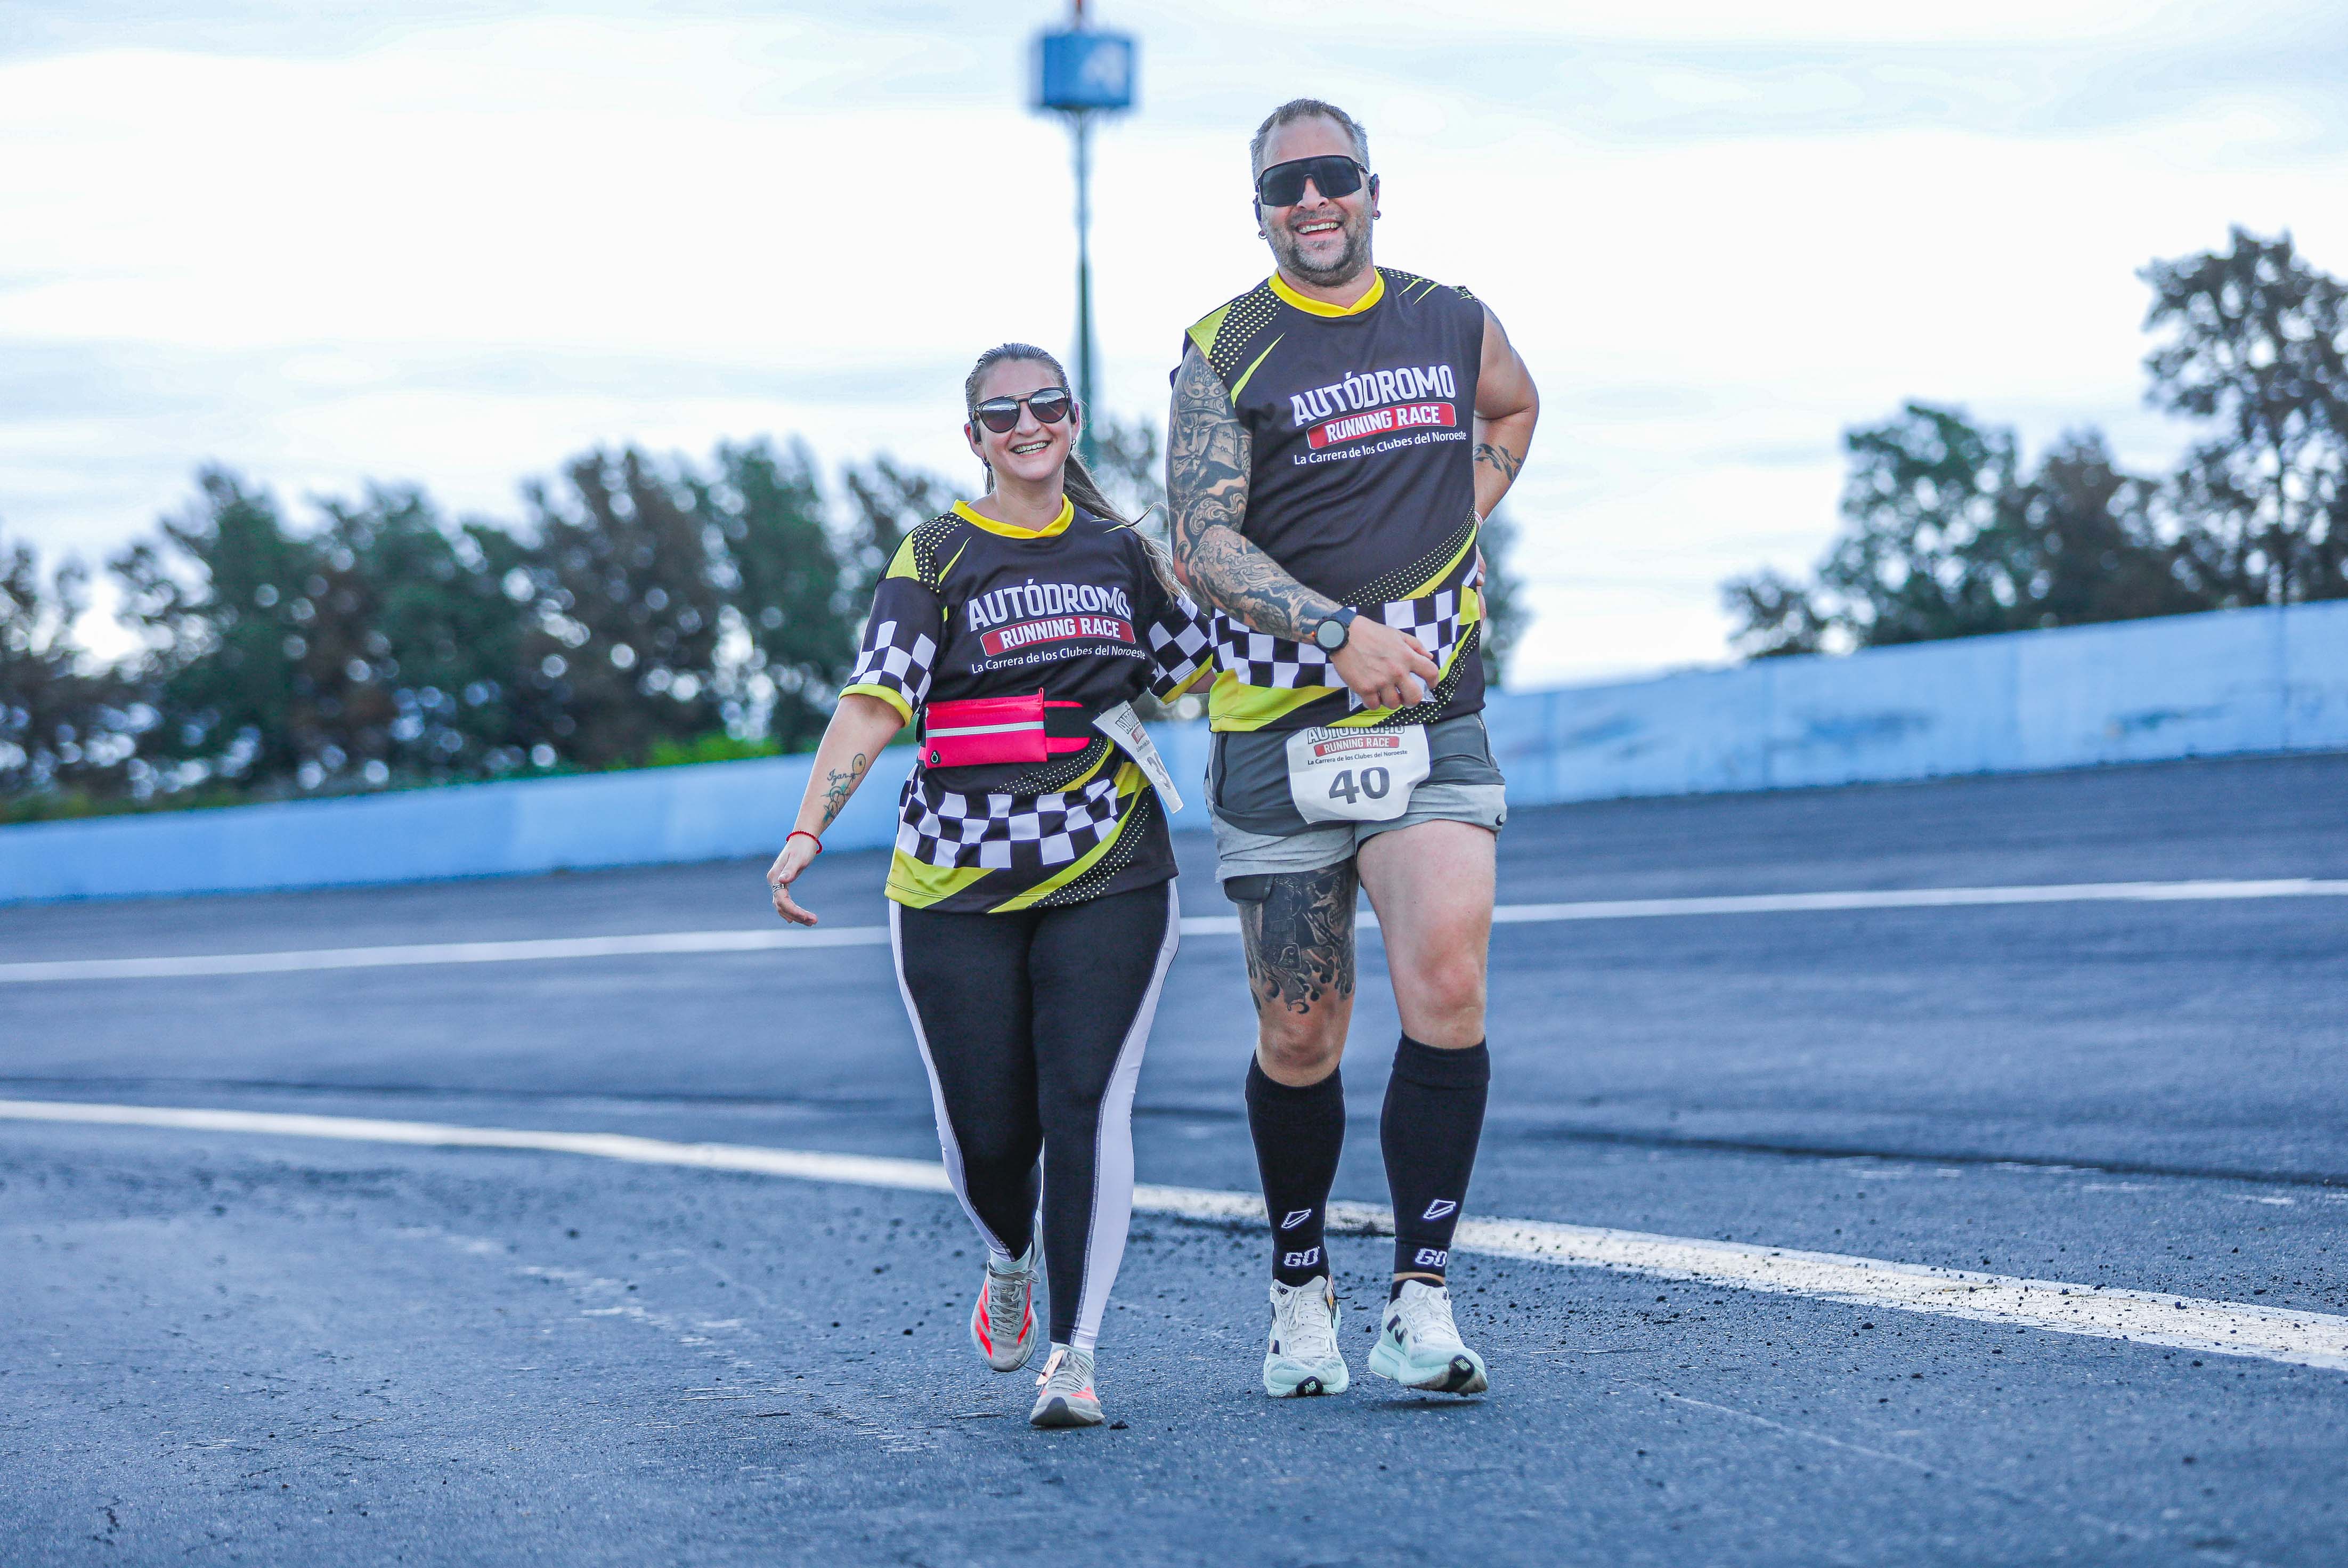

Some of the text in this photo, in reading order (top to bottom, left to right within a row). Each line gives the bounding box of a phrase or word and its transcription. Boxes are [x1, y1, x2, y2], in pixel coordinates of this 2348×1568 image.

[1289, 365, 1457, 427] AUTÓDROMO
[1325, 405, 1441, 443] RUNNING RACE
[1294, 430, 1467, 465] La Carrera de los Clubes del Noroeste
[968, 578, 1131, 632] AUTÓDROMO
[999, 617, 1121, 649] RUNNING RACE
[971, 645, 1145, 674] La Carrera de los Clubes del Noroeste
[1323, 737, 1390, 753] RUNNING RACE
[1328, 767, 1390, 805] 40
